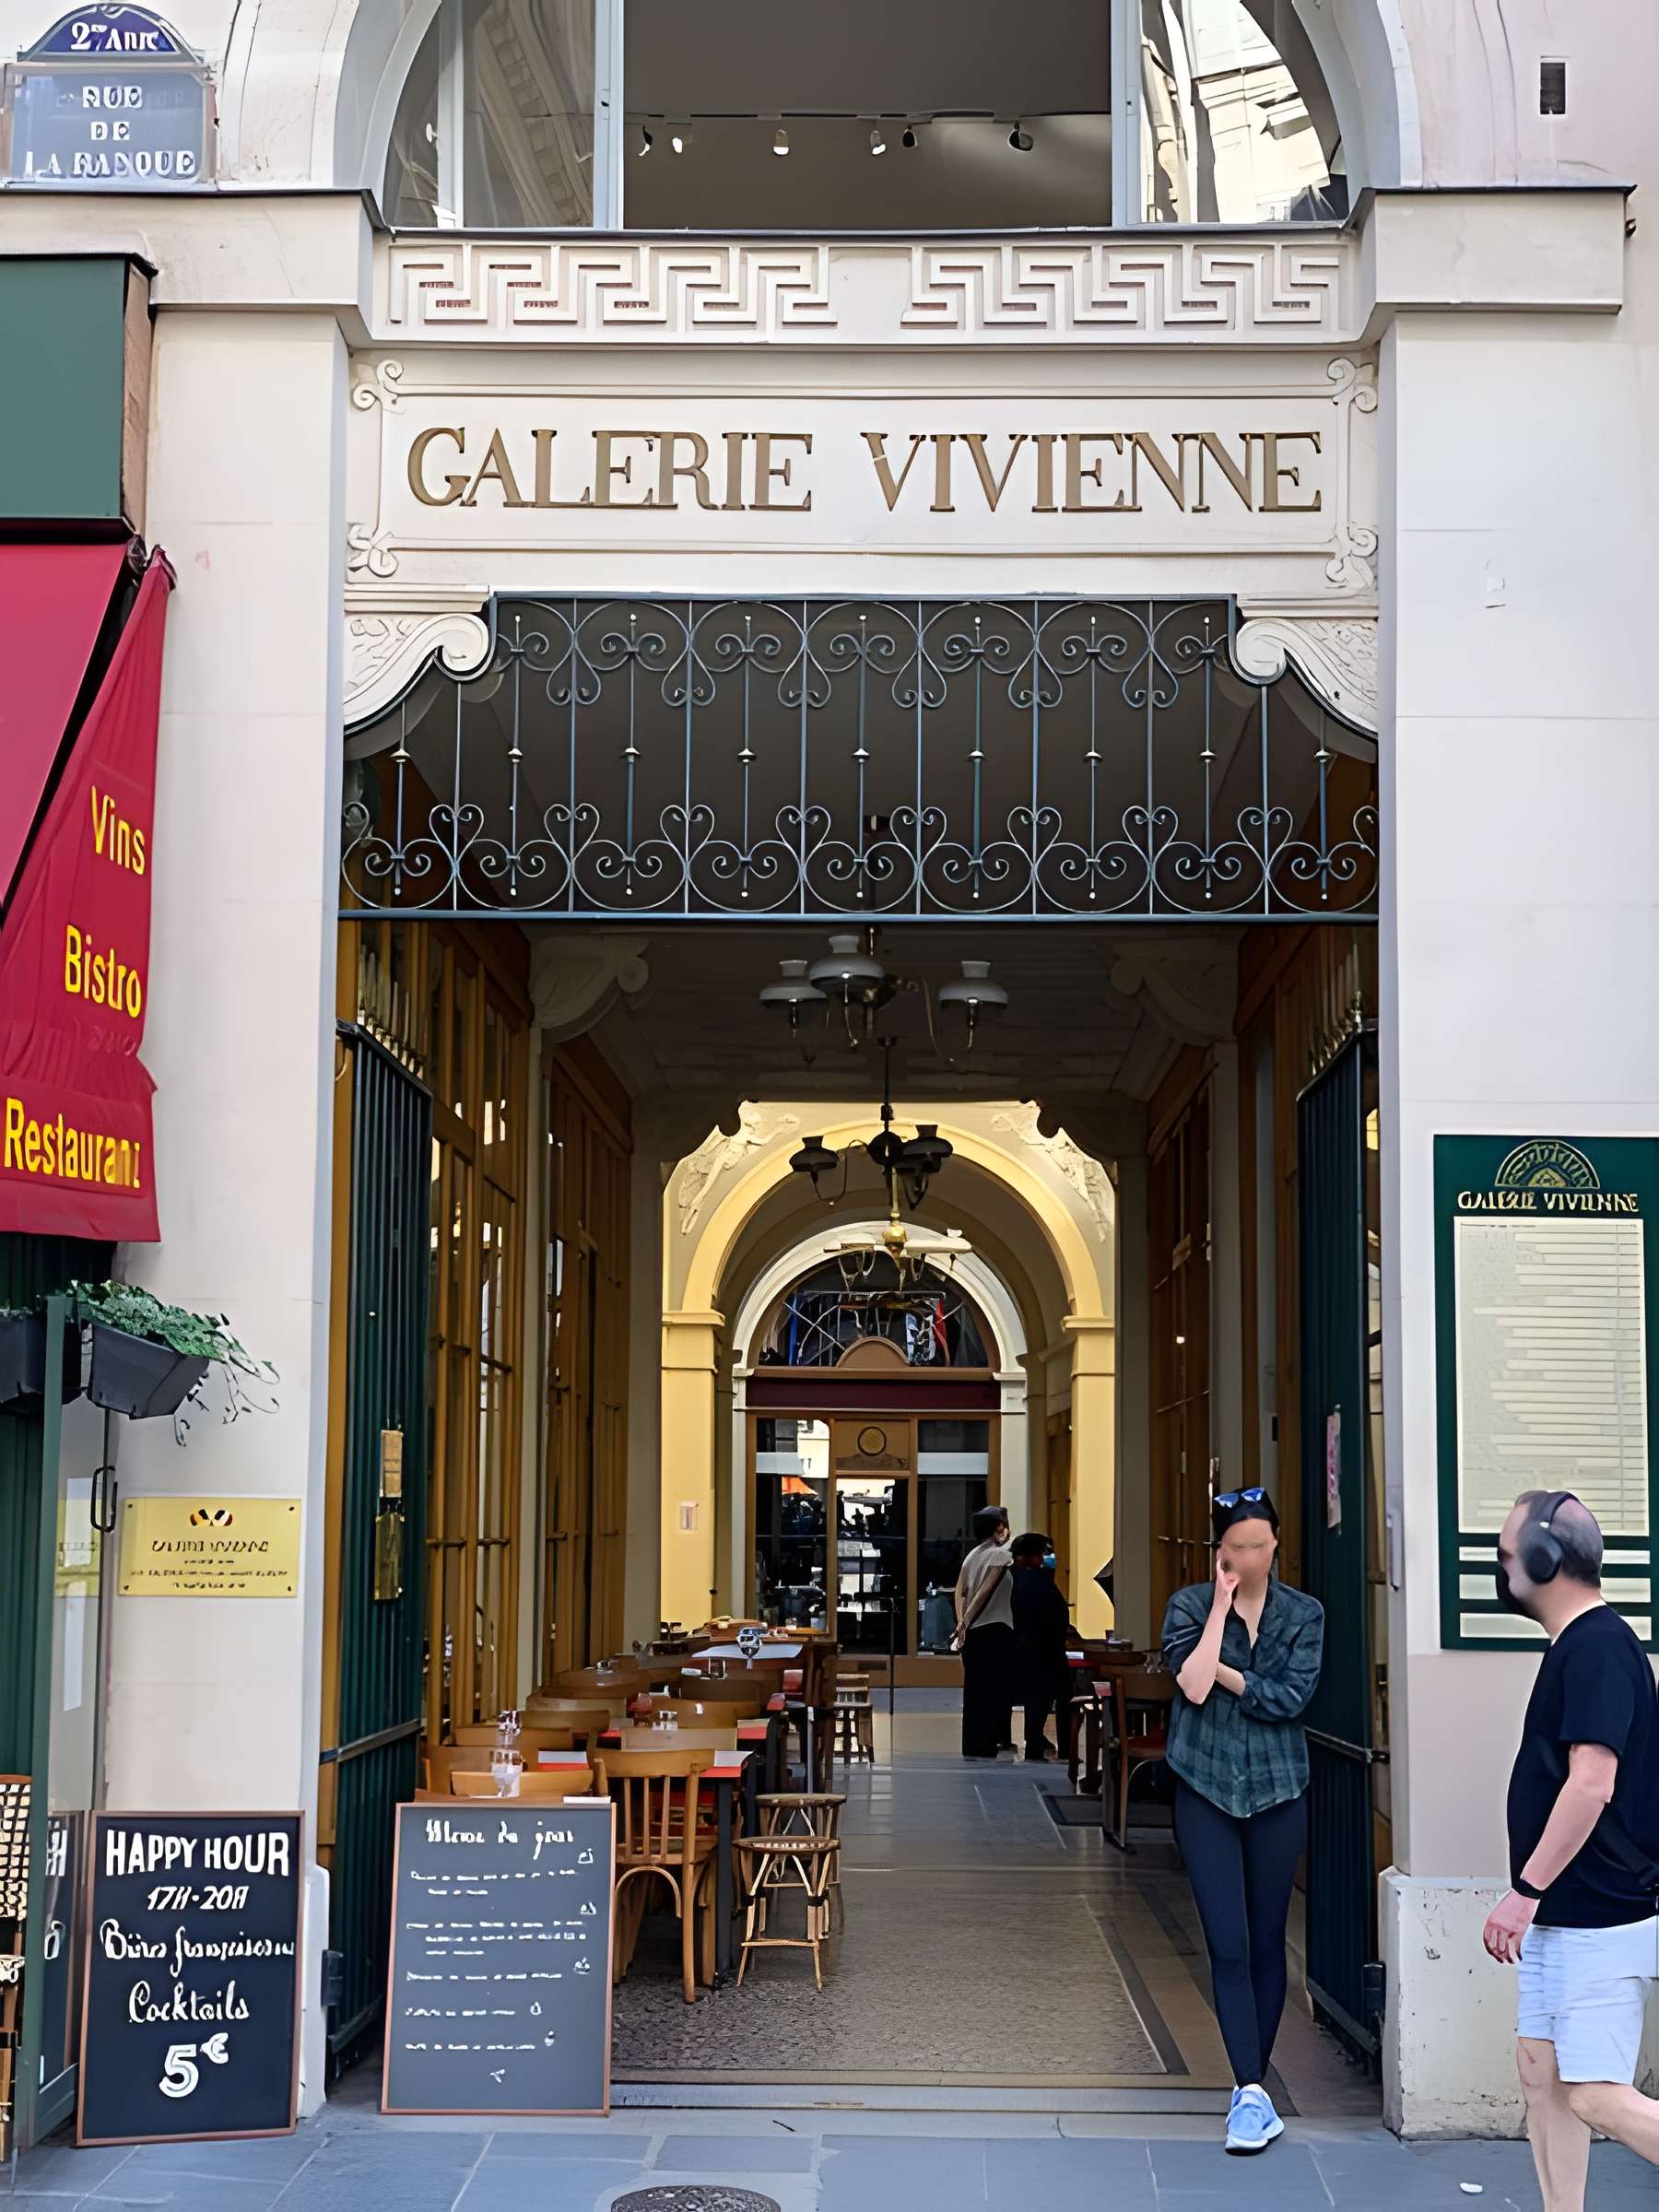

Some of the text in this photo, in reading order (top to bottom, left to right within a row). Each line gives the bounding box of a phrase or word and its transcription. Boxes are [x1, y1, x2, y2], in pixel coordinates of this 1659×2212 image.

[91, 121, 130, 140] DE
[407, 427, 1322, 512] GALERIE VIVIENNE
[90, 785, 146, 875] Vins
[65, 924, 142, 1018] Bistro
[4, 1098, 141, 1189] Restaurant
[105, 1830, 198, 1877] HAPPY
[204, 1832, 289, 1877] HOUR
[128, 1980, 250, 2024] Cocktails
